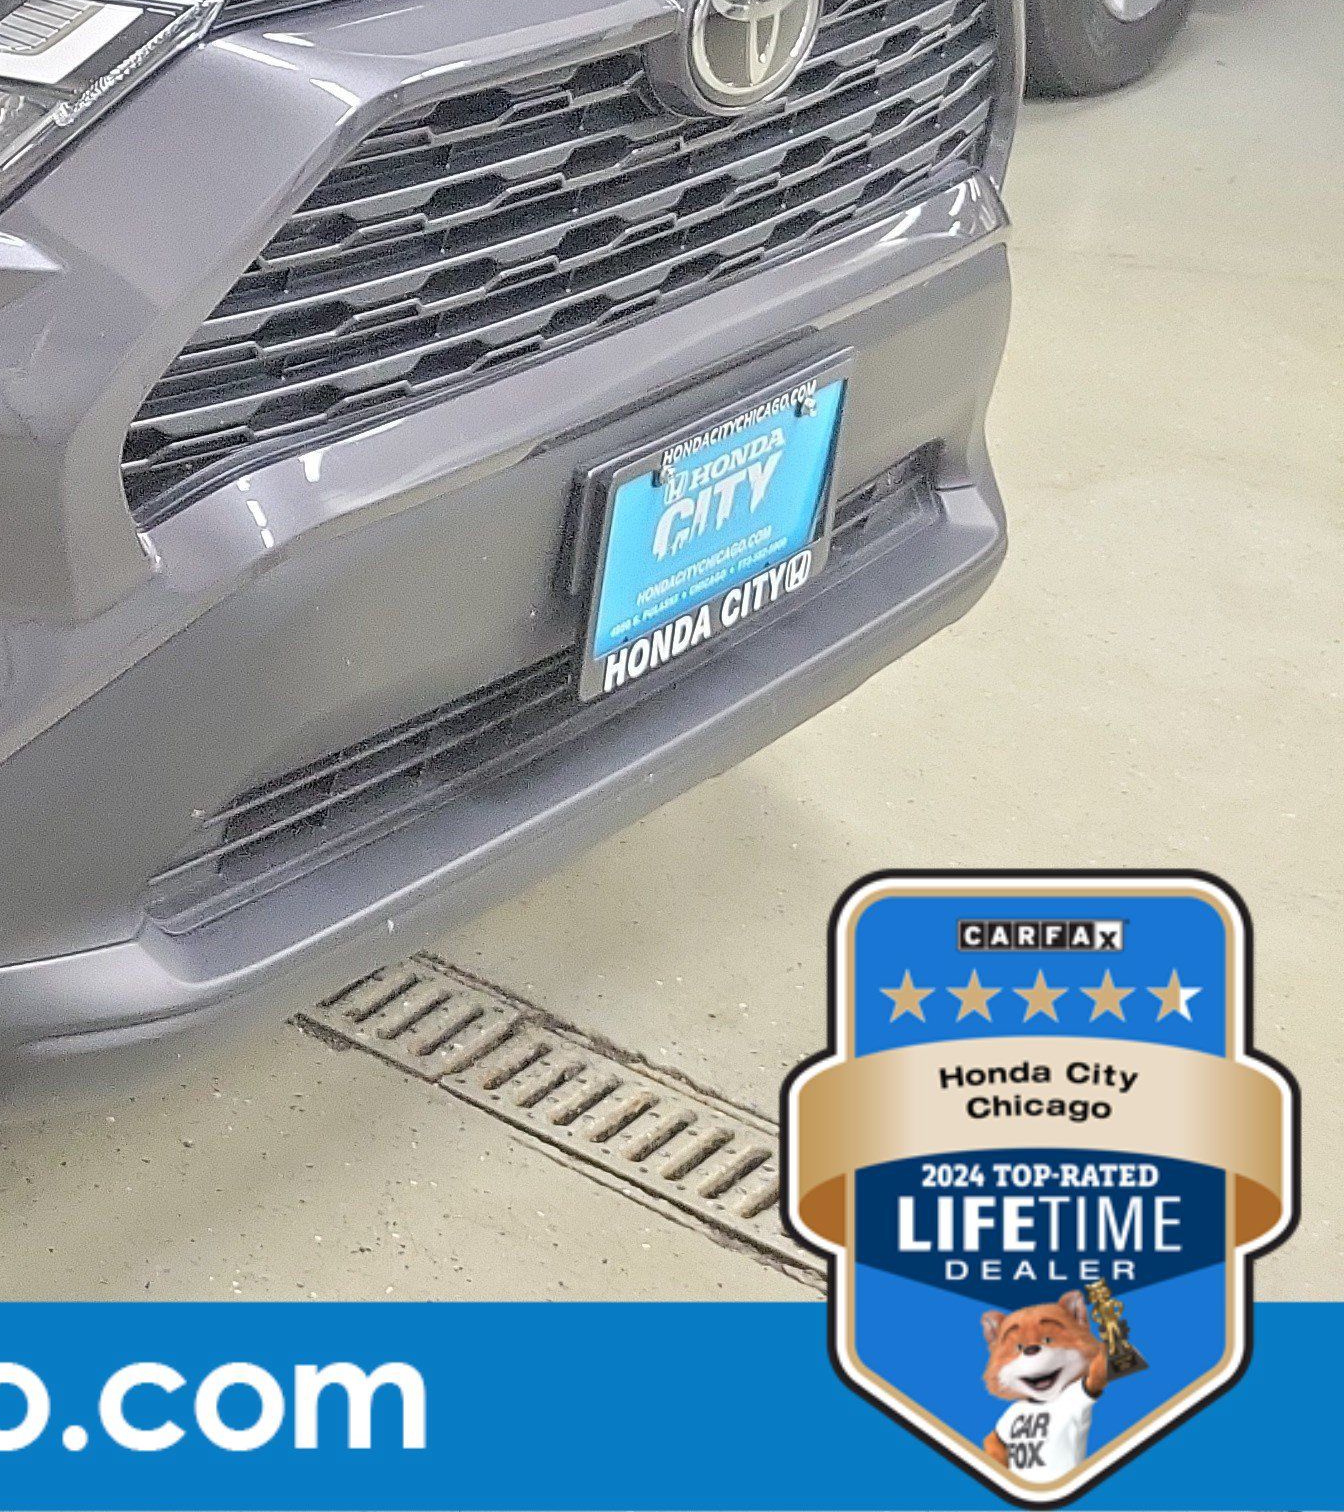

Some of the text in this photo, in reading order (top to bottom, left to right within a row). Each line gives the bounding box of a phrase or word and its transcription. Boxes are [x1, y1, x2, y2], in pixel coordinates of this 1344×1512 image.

[662, 379, 818, 466] HONDACITYCHICAGO.COM
[688, 426, 787, 493] HONDA
[652, 449, 785, 562] CITY
[636, 524, 773, 607] HONDACITYCHICAGO.COM
[603, 561, 787, 693] HONDA CITY
